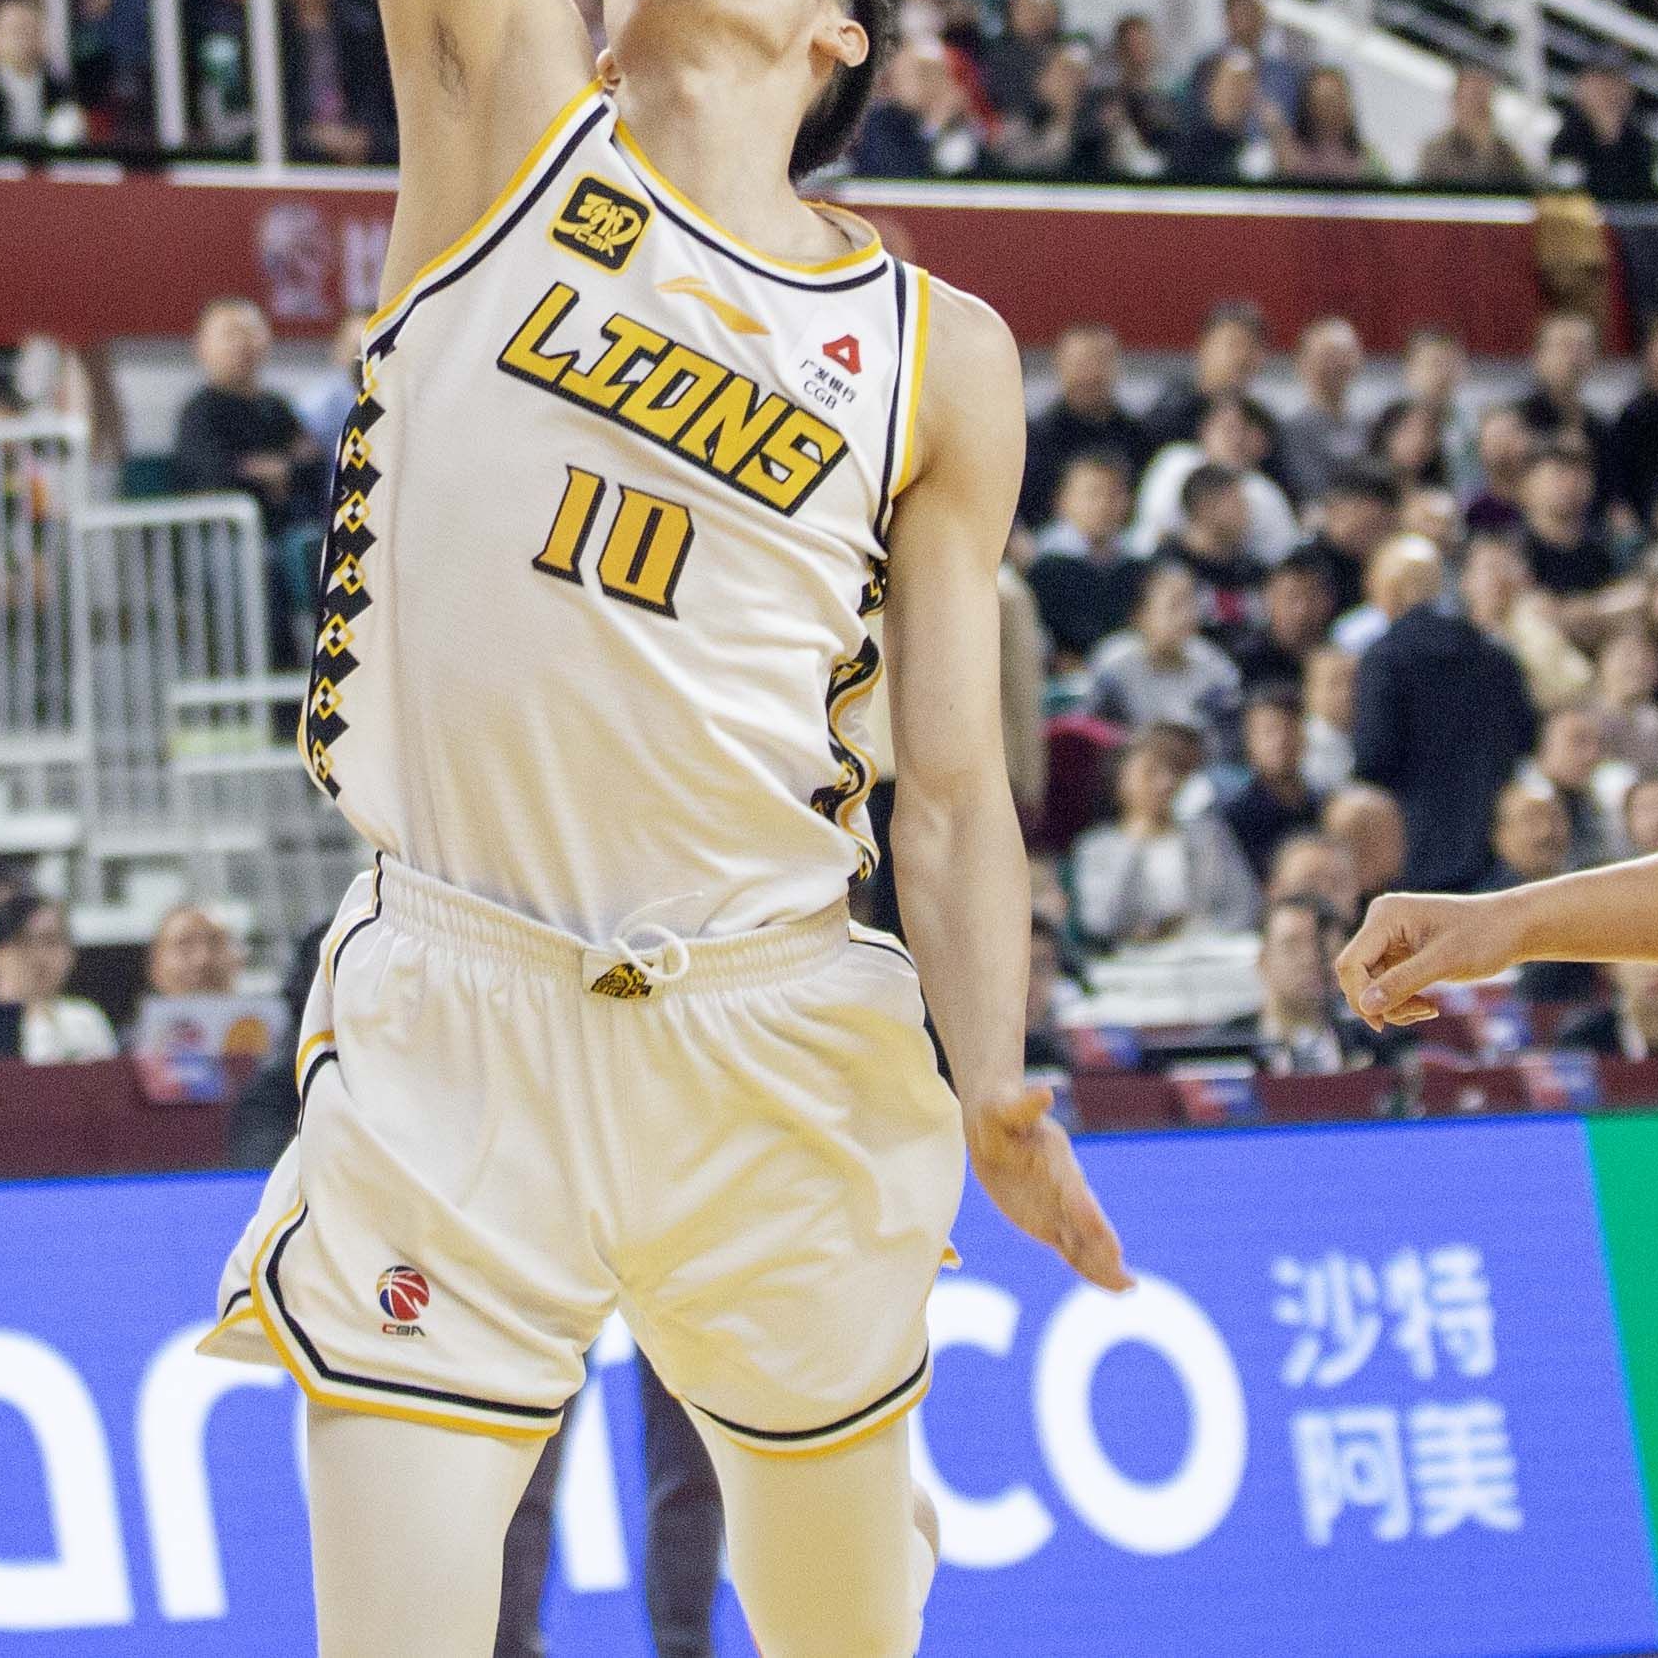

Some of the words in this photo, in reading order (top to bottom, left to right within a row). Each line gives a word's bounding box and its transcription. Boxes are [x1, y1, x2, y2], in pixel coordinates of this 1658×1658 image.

[496, 280, 850, 518] LIONS
[803, 379, 838, 411] CGB
[532, 464, 696, 620] 10
[381, 1322, 426, 1337] CBA
[1271, 1243, 1496, 1388] 沙特
[1292, 1396, 1524, 1546] 阿美
